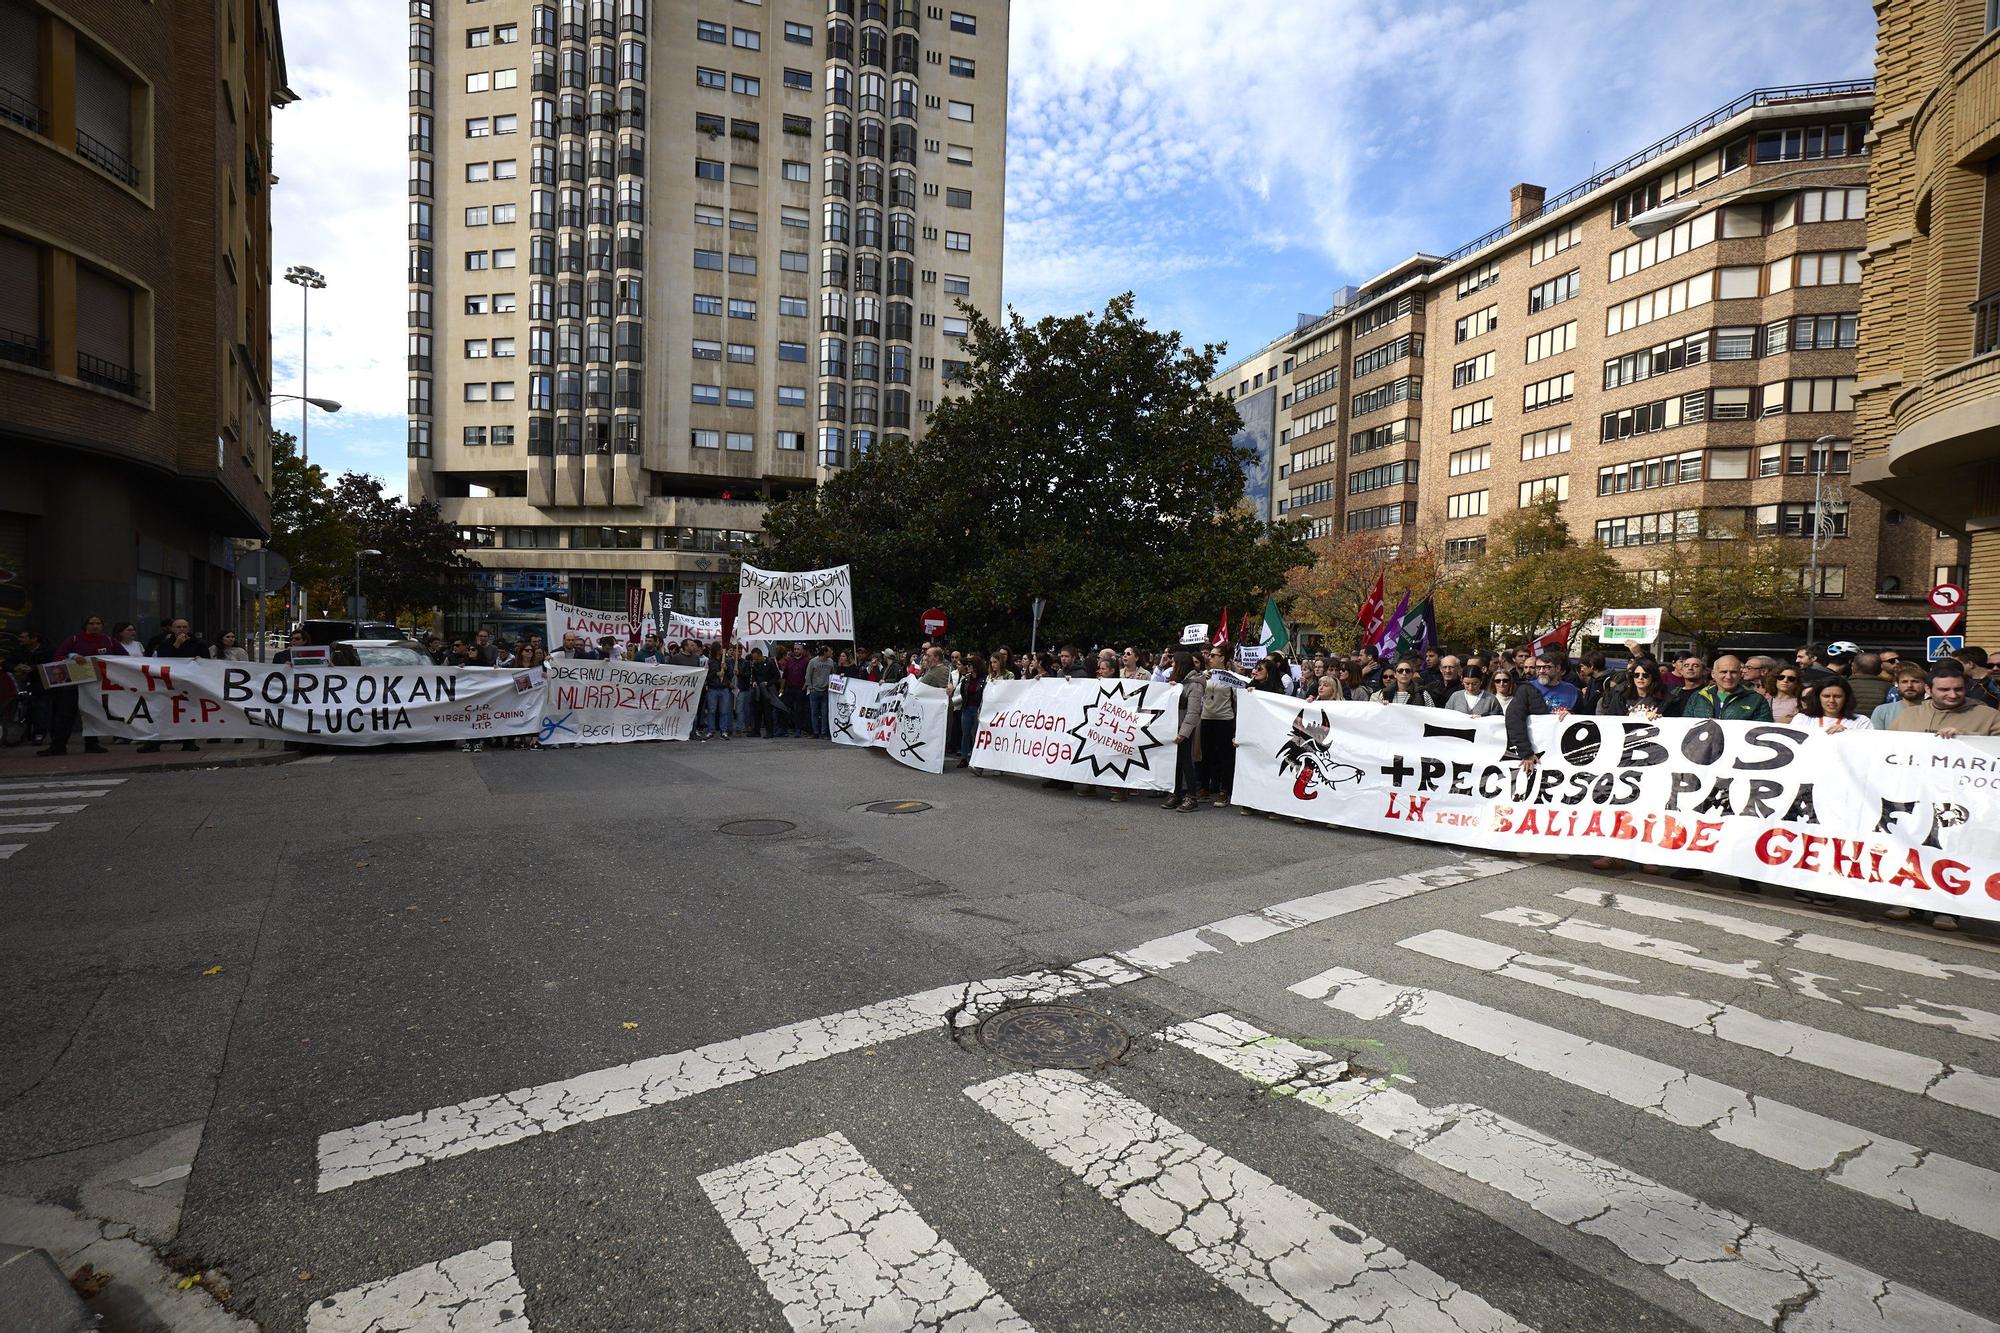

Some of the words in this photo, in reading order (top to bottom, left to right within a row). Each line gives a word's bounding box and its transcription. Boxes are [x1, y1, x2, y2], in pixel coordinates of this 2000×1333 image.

[663, 593, 673, 609] BAI
[757, 588, 846, 609] IRAKASLEOK
[555, 602, 593, 618] Hartos
[597, 612, 612, 620] de
[698, 617, 710, 627] de
[567, 617, 630, 635] LANBID
[1832, 622, 1920, 633] ESQUINA
[224, 668, 456, 705] BORROKAN
[102, 693, 153, 724] LA
[171, 694, 225, 724] F.P.
[244, 707, 285, 729] EN
[307, 706, 412, 734] LUCHA
[433, 714, 471, 722] VIRGEN
[476, 712, 491, 722] DEL
[493, 710, 524, 719] CAMINO
[990, 711, 1009, 728] LH
[1009, 709, 1066, 733] Greban
[1101, 701, 1140, 724] AZAROAK
[1095, 713, 1137, 742] 3-4-5
[976, 731, 992, 751] FP
[994, 735, 1009, 752] en
[1013, 732, 1072, 764] huelga
[1087, 728, 1135, 756] NOVIEMBRE
[1500, 718, 1809, 770] OBOS
[1931, 755, 2000, 772] MARI
[1665, 772, 1820, 825] PARA
[1872, 797, 1970, 850] FP
